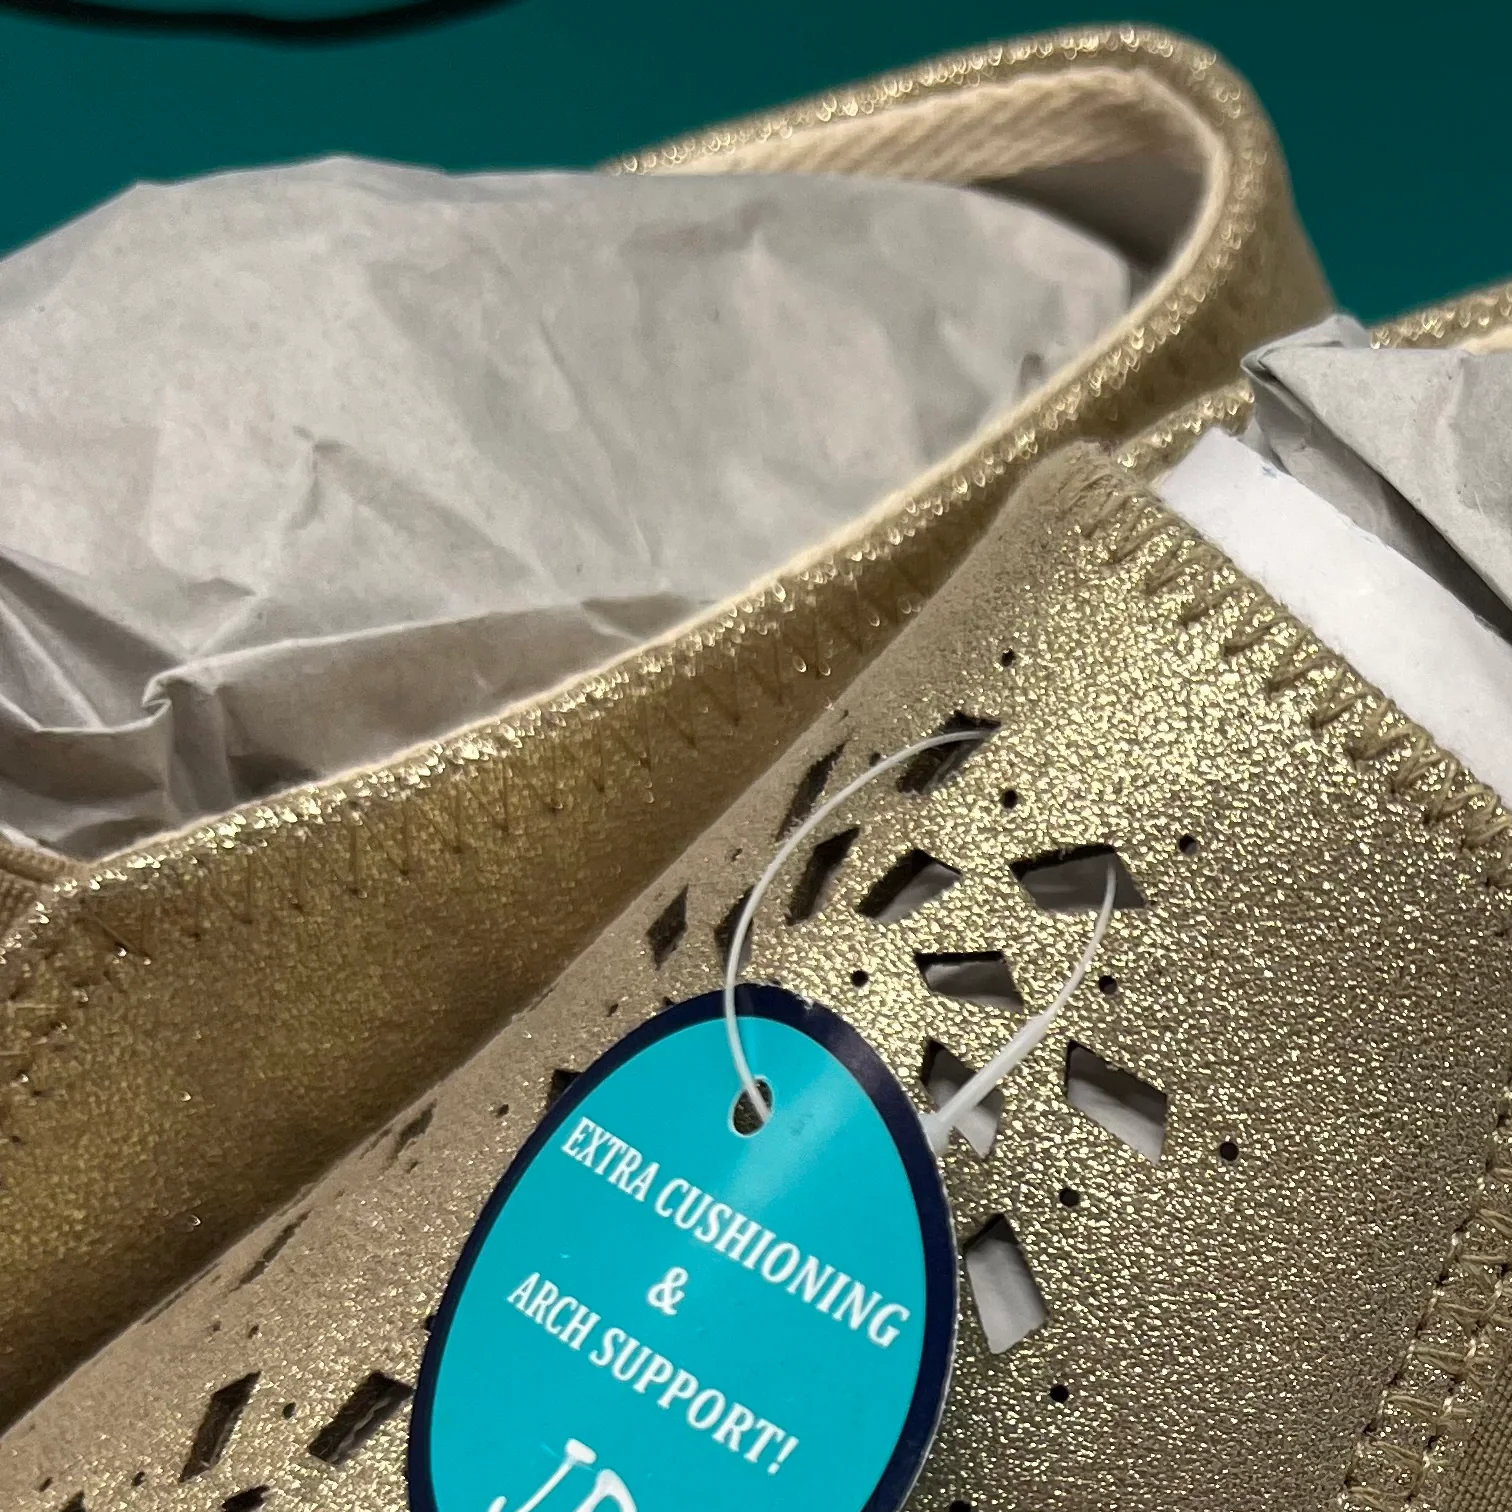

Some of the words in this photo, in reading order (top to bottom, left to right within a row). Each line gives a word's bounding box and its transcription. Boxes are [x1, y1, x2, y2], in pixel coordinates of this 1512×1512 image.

[560, 1116, 661, 1202] EXTRA
[655, 1178, 910, 1348] CUSHIONING
[647, 1266, 690, 1316] &
[507, 1272, 601, 1350] ARCH
[589, 1327, 800, 1474] SUPPORT!
